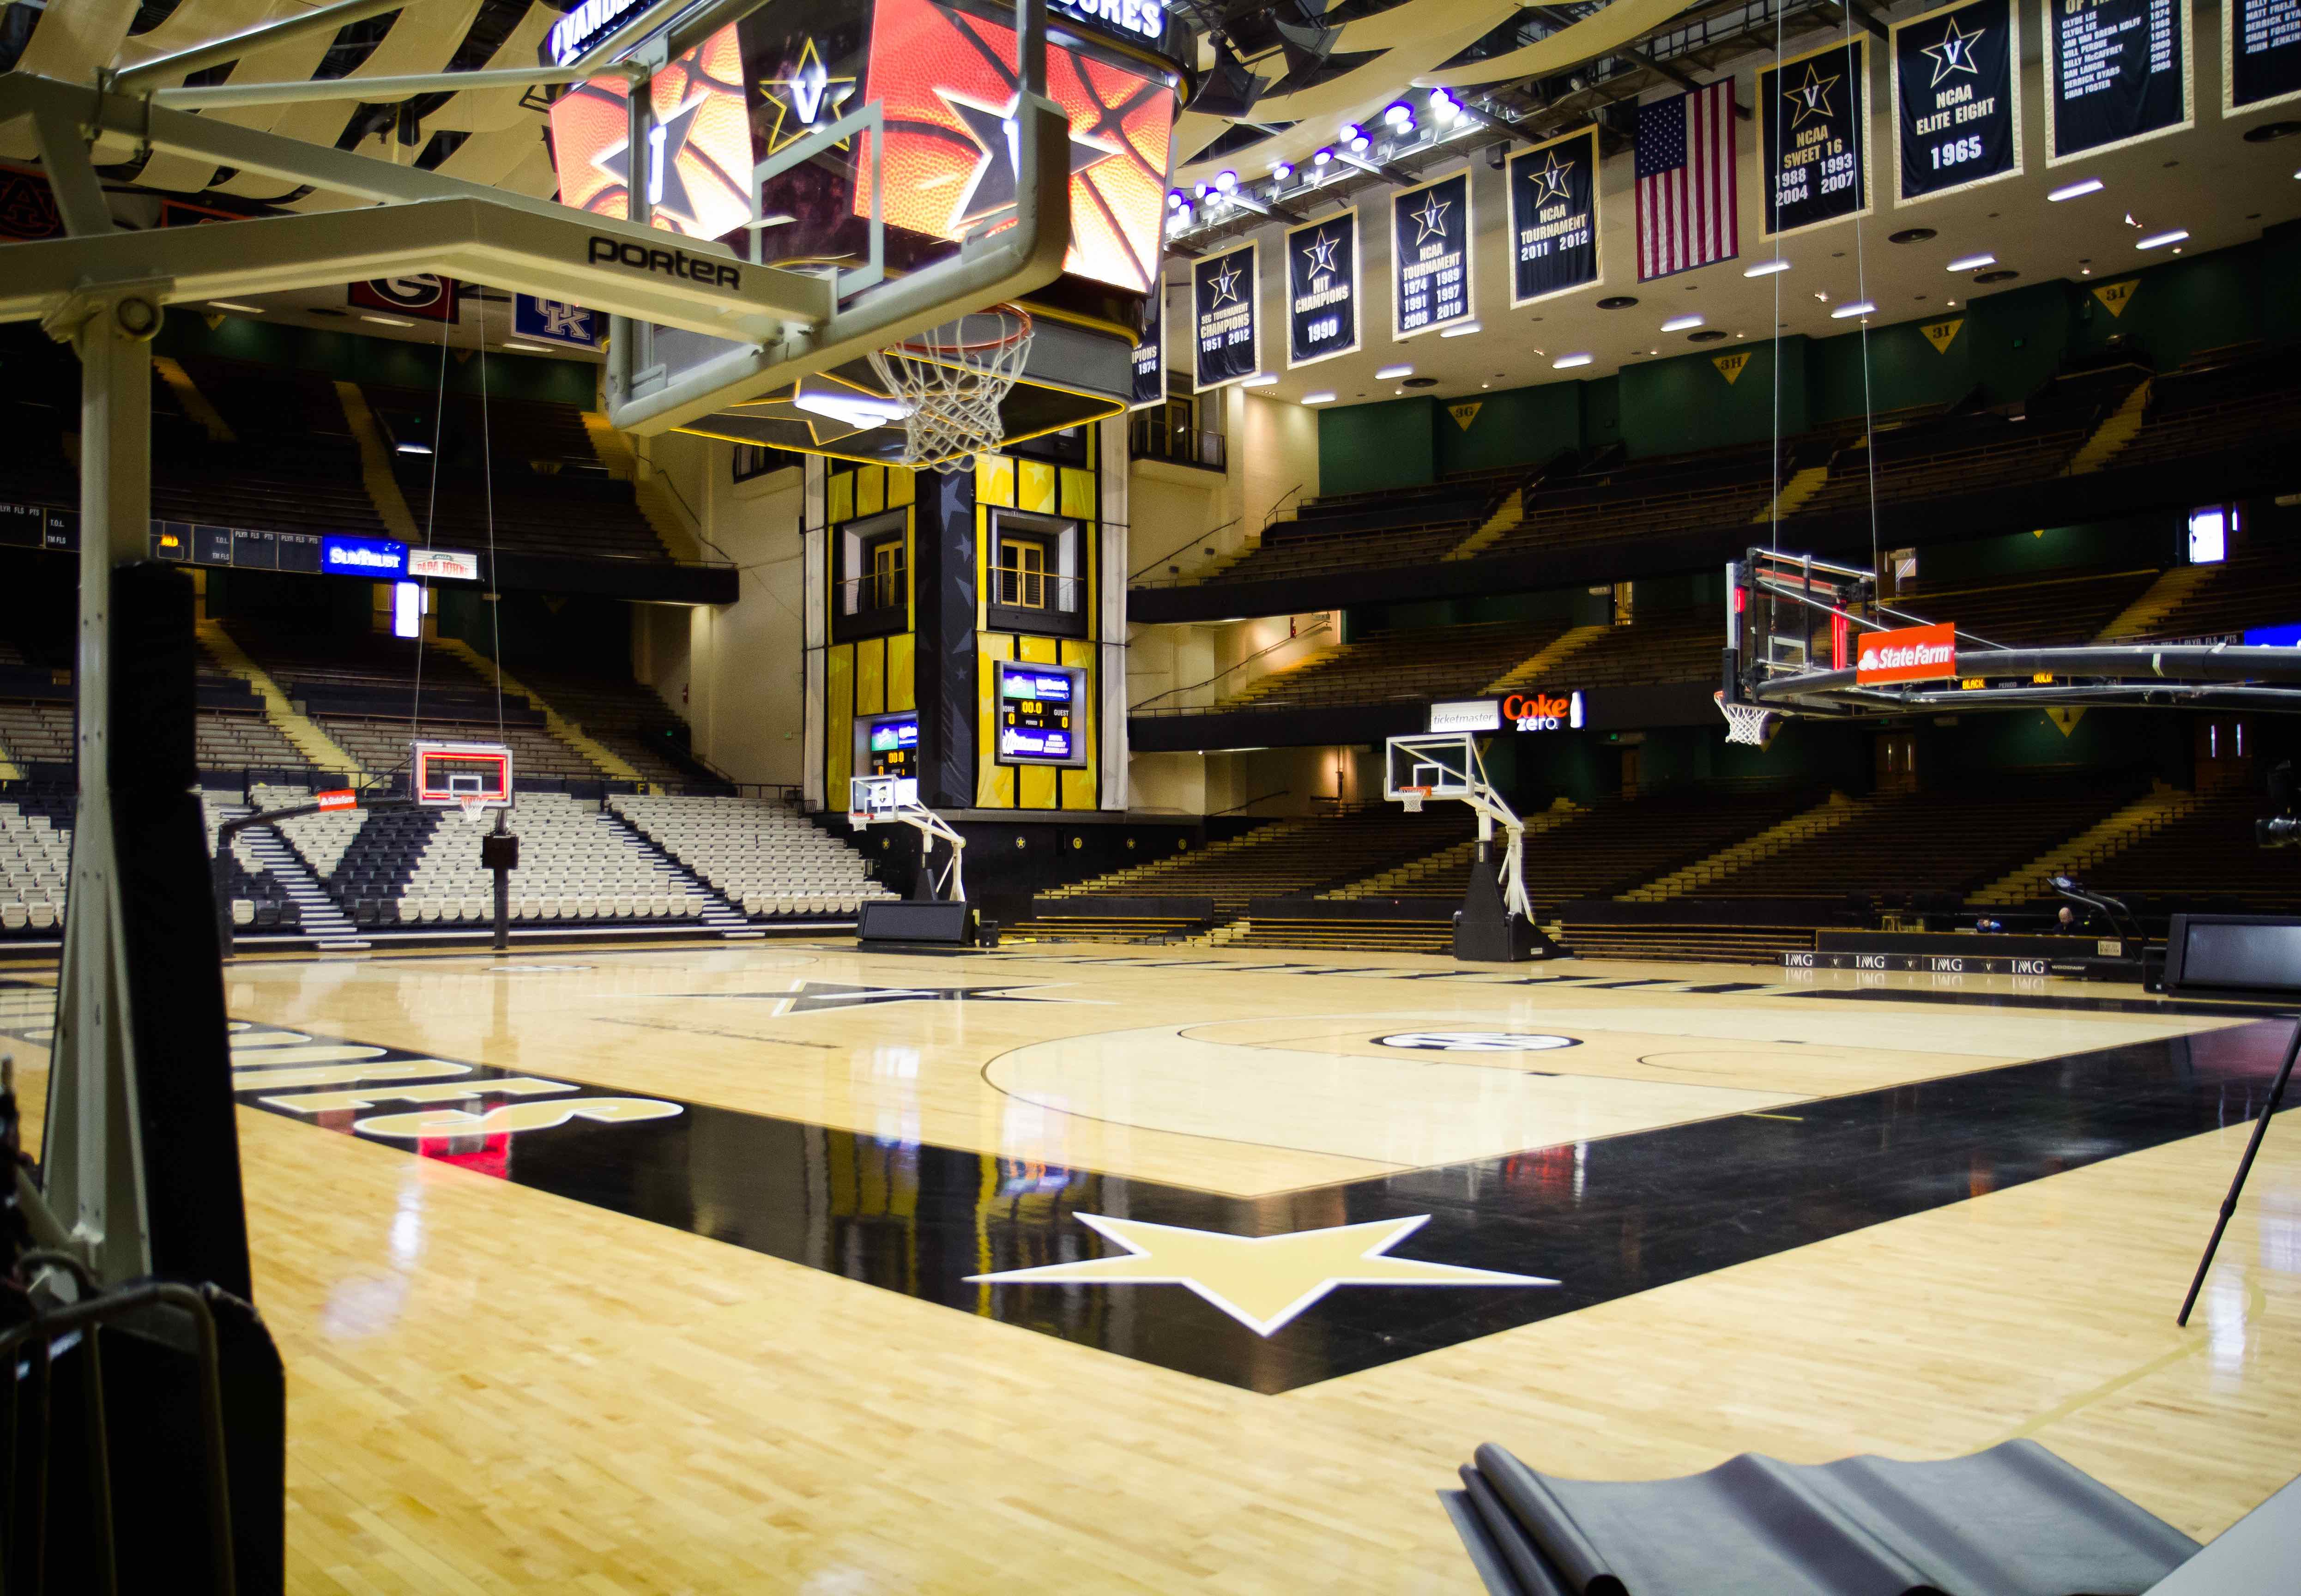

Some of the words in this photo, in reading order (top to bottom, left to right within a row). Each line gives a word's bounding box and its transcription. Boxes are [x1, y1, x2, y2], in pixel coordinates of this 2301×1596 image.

[2062, 15, 2084, 29] CLYDE
[2085, 11, 2097, 22] LEE
[2150, 7, 2170, 20] 1974
[2246, 7, 2267, 21] MATT
[2246, 14, 2282, 32] DERRICK
[2062, 25, 2084, 39] CLYDE
[2085, 21, 2097, 32] LEE
[2063, 38, 2077, 49] JAN
[2078, 33, 2092, 44] VAN
[2119, 16, 2142, 31] KOLFF
[2246, 30, 2268, 43] SHAN
[2271, 20, 2301, 36] FOSTER
[2063, 48, 2078, 60] WILL
[2081, 38, 2108, 54] PERDUE
[2150, 39, 2170, 52] 2000
[2151, 49, 2170, 63] 2007
[2246, 41, 2268, 54] JOHN
[2063, 56, 2082, 69] BILLY
[2151, 60, 2171, 74] 2008
[2064, 68, 2078, 79] DAN
[2064, 74, 2095, 90] DERRICK
[2096, 66, 2120, 80] BYARS
[1936, 84, 1973, 109] NCAA
[2065, 87, 2083, 100] SHAN
[2085, 79, 2111, 93] FOSTER
[1916, 111, 1951, 135] ELITE
[1955, 97, 1995, 124] EIGHT
[1796, 125, 1829, 148] NCAA
[1784, 145, 1821, 169] SWEET
[1826, 139, 1842, 156] 16
[1931, 135, 1981, 169] 1965
[1775, 168, 1806, 188] 1988
[1820, 153, 1853, 176] 1993
[1775, 185, 1808, 207] 2004
[1821, 170, 1854, 194] 2007
[1540, 203, 1566, 224] NCAA
[1521, 213, 1586, 245] TOURNAMENT
[1419, 242, 1443, 261] NCAA
[1521, 242, 1548, 261] 2011
[1559, 230, 1588, 251] 2012
[1403, 252, 1460, 281] TOURNAMENT
[1313, 276, 1329, 295] NIT
[1404, 278, 1427, 296] 1974
[1436, 268, 1459, 287] 1989
[1295, 285, 1348, 314] CHAMPIONS
[1404, 295, 1426, 313] 1991
[1437, 284, 1460, 303] 1997
[1202, 314, 1212, 325] SEC
[1213, 302, 1249, 321] TOURNAMENT
[1404, 311, 1428, 329] 2008
[1437, 301, 1461, 320] 2010
[1201, 313, 1250, 339] CHAMPIONS
[1308, 319, 1337, 343] 1990
[1202, 337, 1222, 353] 1951
[1228, 329, 1250, 345] 2012
[1139, 360, 1156, 375] 1974
[55, 536, 66, 544] FLS
[417, 561, 438, 573] PAPA
[2224, 635, 2237, 644] PTS
[1962, 679, 1984, 690] BLACK
[1503, 694, 1569, 720] Coke
[1434, 713, 1493, 725] ticketmaster
[1785, 954, 1813, 967] IMG
[1855, 955, 1884, 968] IMG
[1932, 958, 1962, 971] IMG
[2011, 960, 2044, 974] IMG
